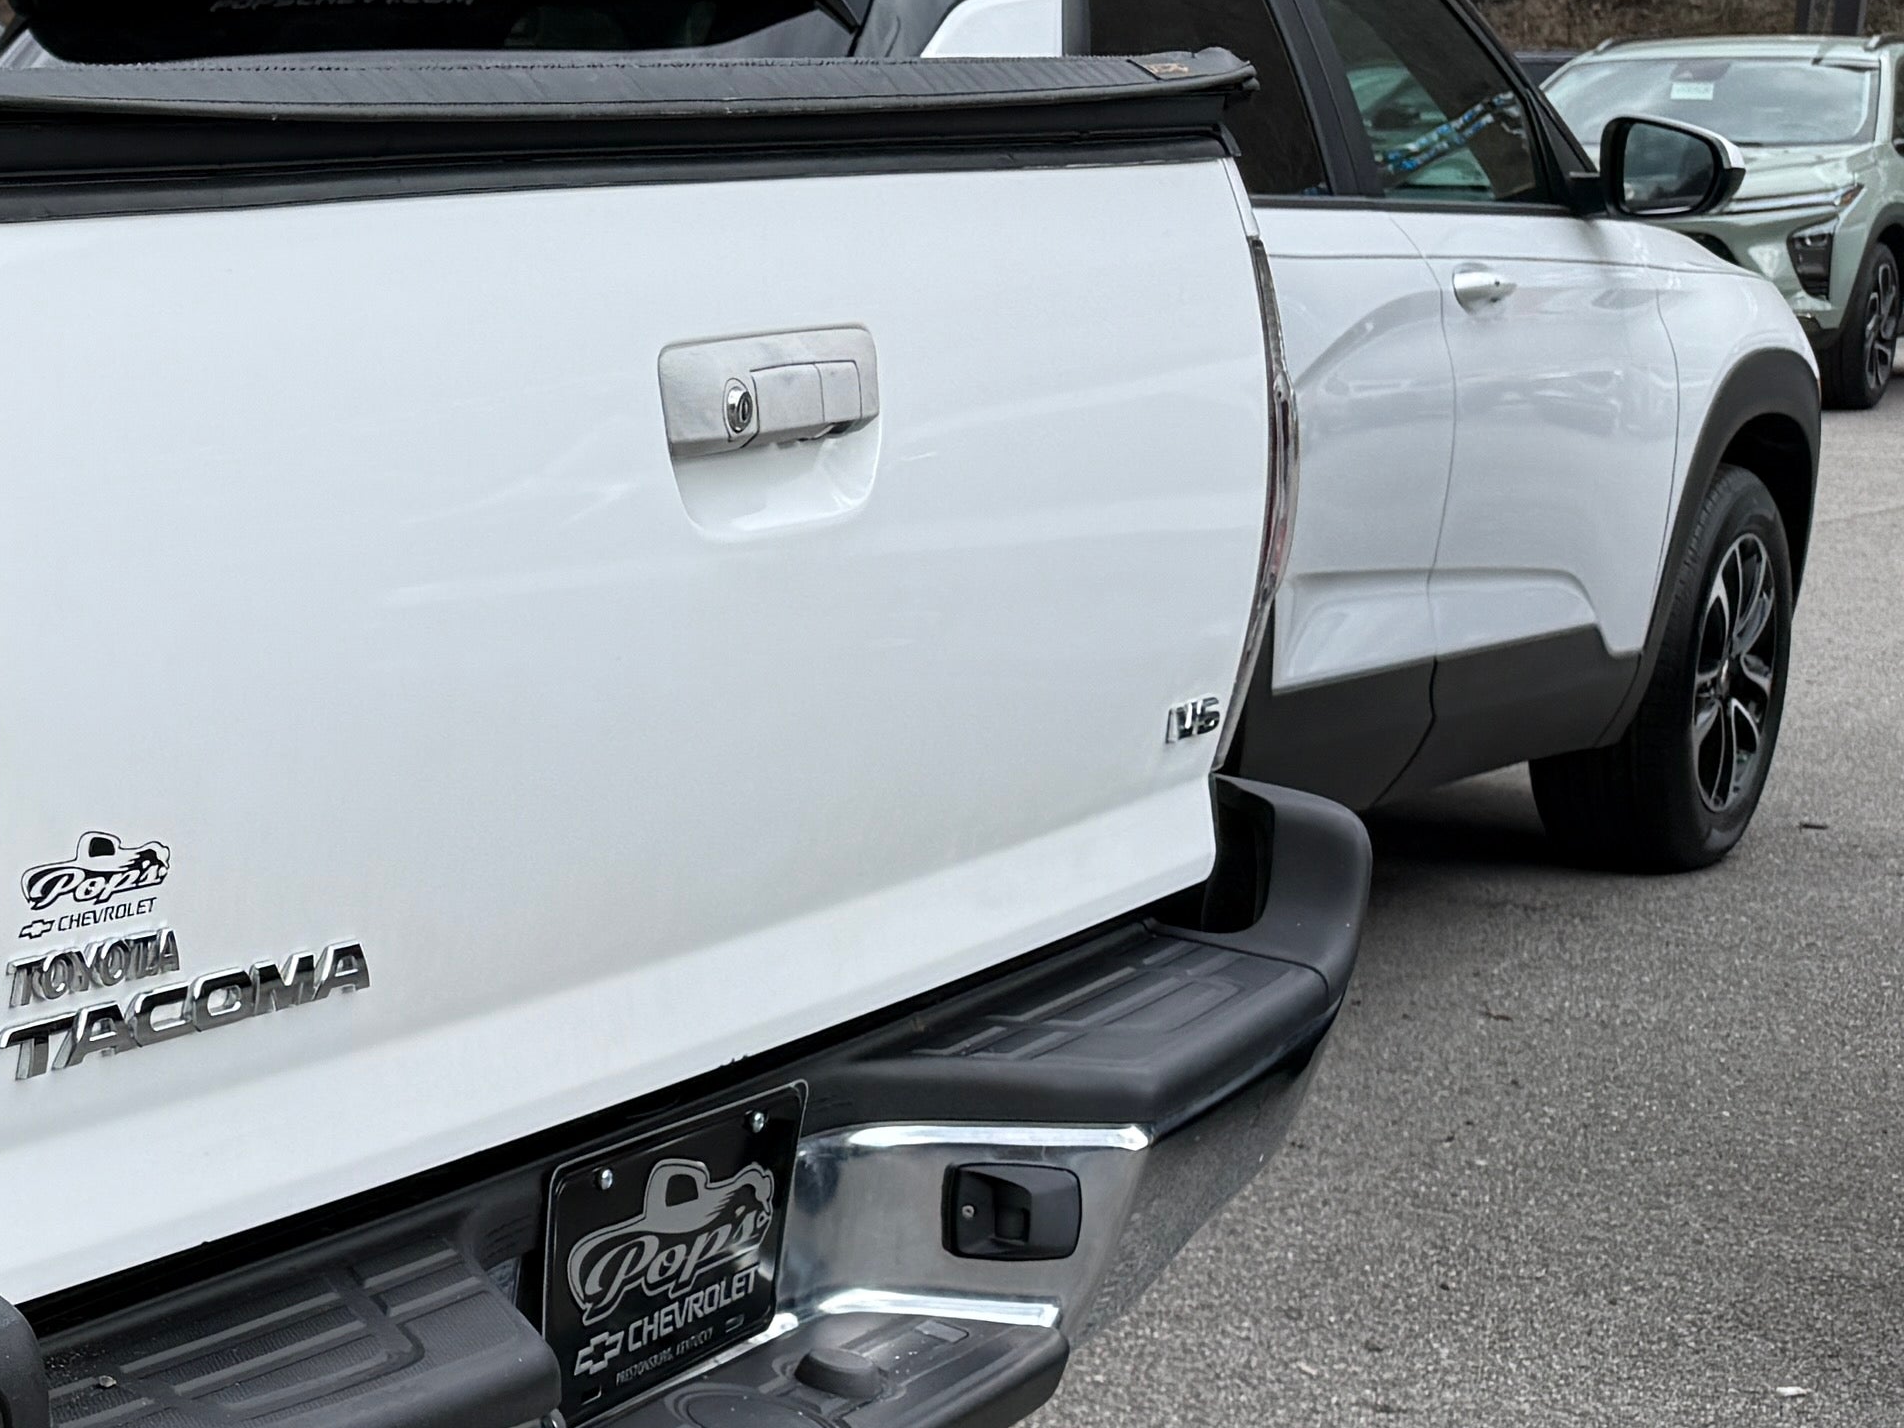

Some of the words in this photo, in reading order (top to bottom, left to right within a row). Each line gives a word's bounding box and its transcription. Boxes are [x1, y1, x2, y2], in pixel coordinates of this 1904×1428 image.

[56, 896, 159, 933] CHEVROLET
[5, 926, 182, 1009] TOYOTA
[583, 1204, 770, 1318] Pop's
[627, 1264, 761, 1353] CHEVROLET
